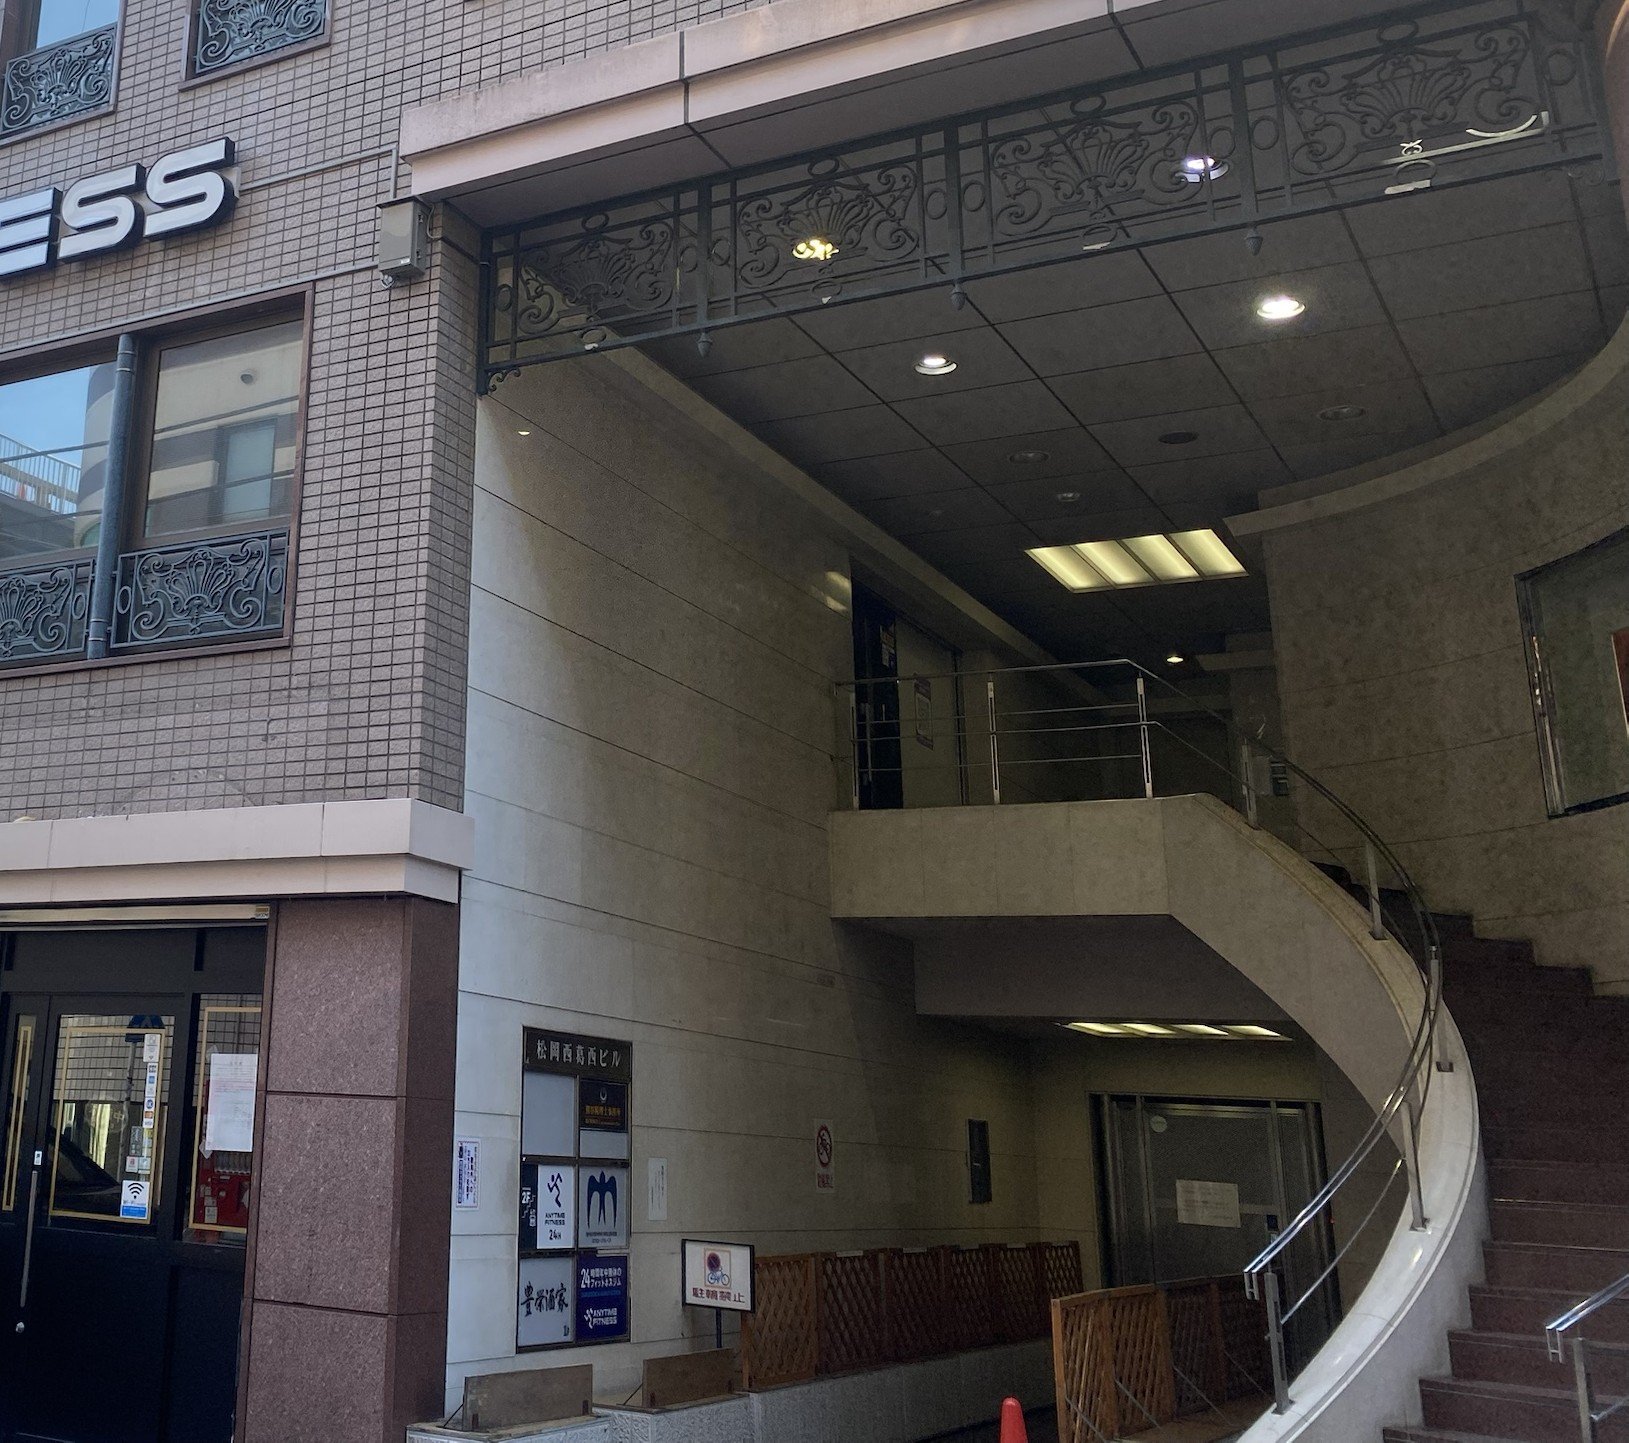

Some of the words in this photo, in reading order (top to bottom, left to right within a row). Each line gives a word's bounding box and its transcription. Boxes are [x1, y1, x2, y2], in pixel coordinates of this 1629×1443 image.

[536, 1038, 622, 1068] 松岡西葛西ビル
[521, 1191, 532, 1204] 2F
[692, 1287, 746, 1304] 駐輪禁止
[593, 1307, 618, 1318] ANYTIME
[592, 1316, 618, 1326] FITNESS
